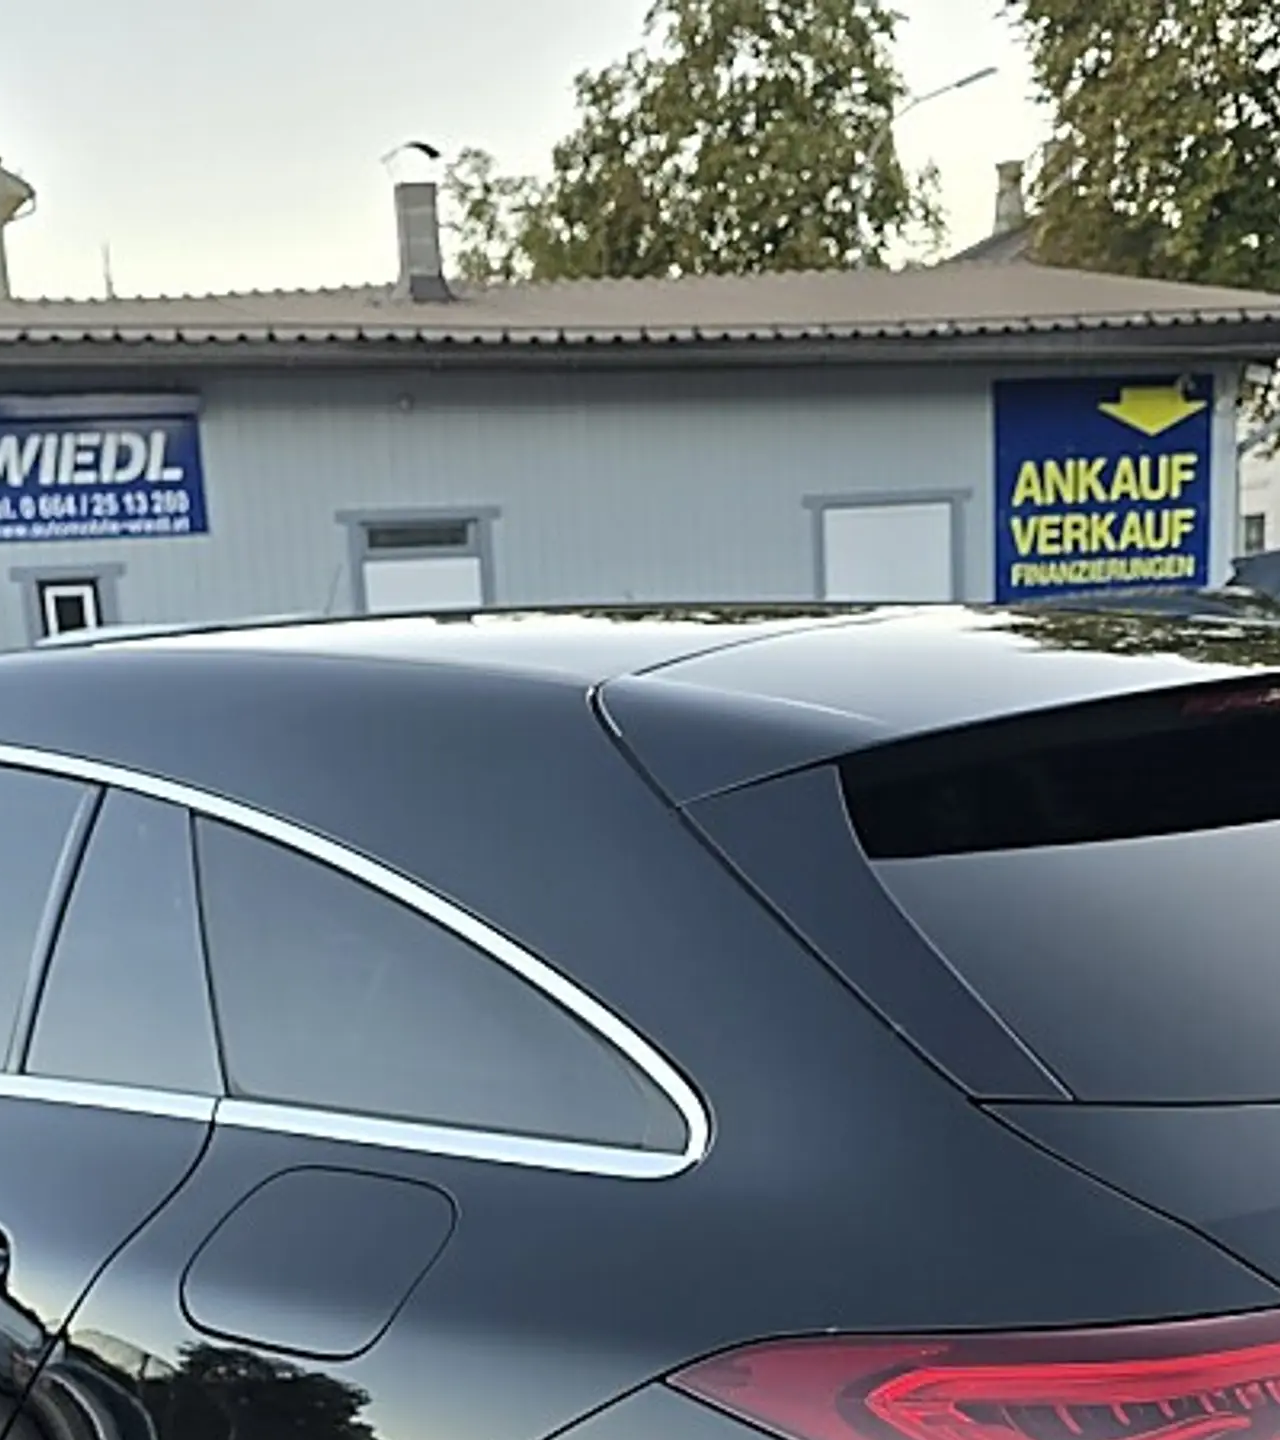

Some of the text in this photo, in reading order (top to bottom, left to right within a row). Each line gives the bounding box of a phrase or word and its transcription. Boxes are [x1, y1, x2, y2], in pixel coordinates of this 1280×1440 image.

[1012, 452, 1198, 507] ANKAUF
[1010, 508, 1196, 556] VERKAUF
[1011, 555, 1195, 587] FINANZIERUNGEN
